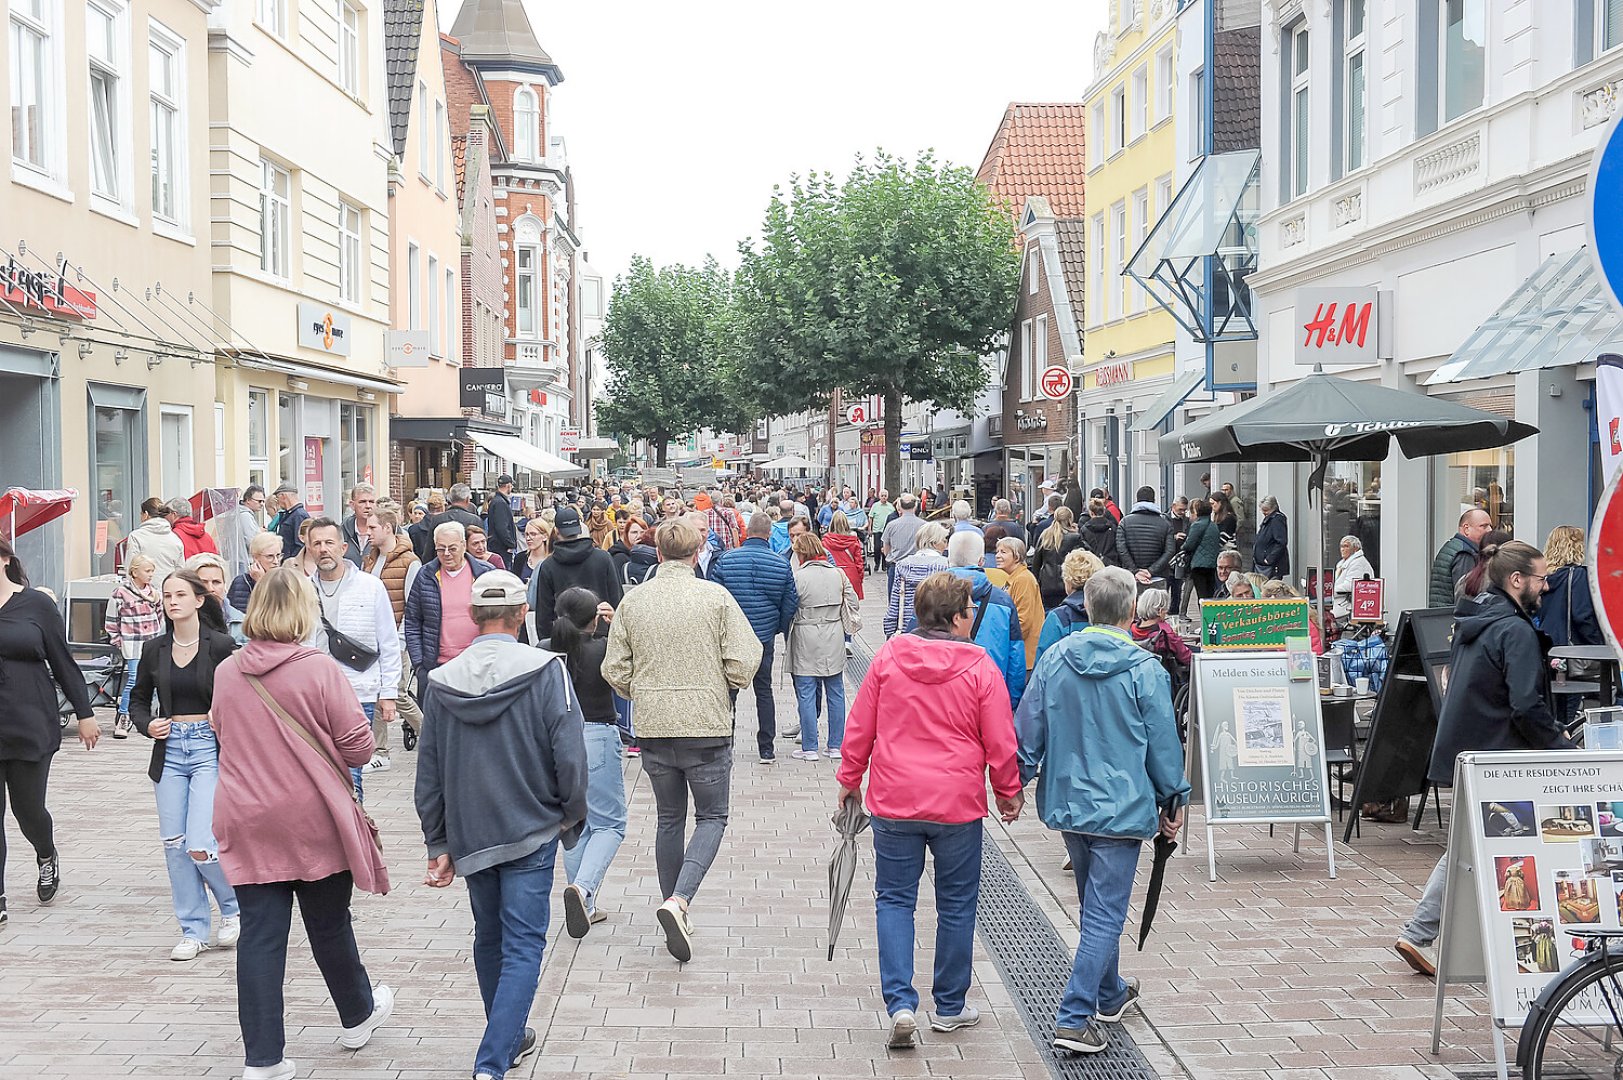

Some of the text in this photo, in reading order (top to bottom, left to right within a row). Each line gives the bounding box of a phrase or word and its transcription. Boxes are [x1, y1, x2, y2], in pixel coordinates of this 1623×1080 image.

[1303, 302, 1373, 349] H&M
[1351, 420, 1425, 433] Tchibo
[1222, 606, 1301, 630] Verkaufsbörse!
[1212, 668, 1287, 678] Melden Sie sich
[1483, 768, 1602, 778] DIE ALTE RESIDENZSTADT
[1214, 780, 1320, 792] HISTORISCHES
[1542, 785, 1570, 794] ZEIGT
[1572, 784, 1594, 793] IHRE
[1214, 792, 1320, 804] MUSEUM AURICH
